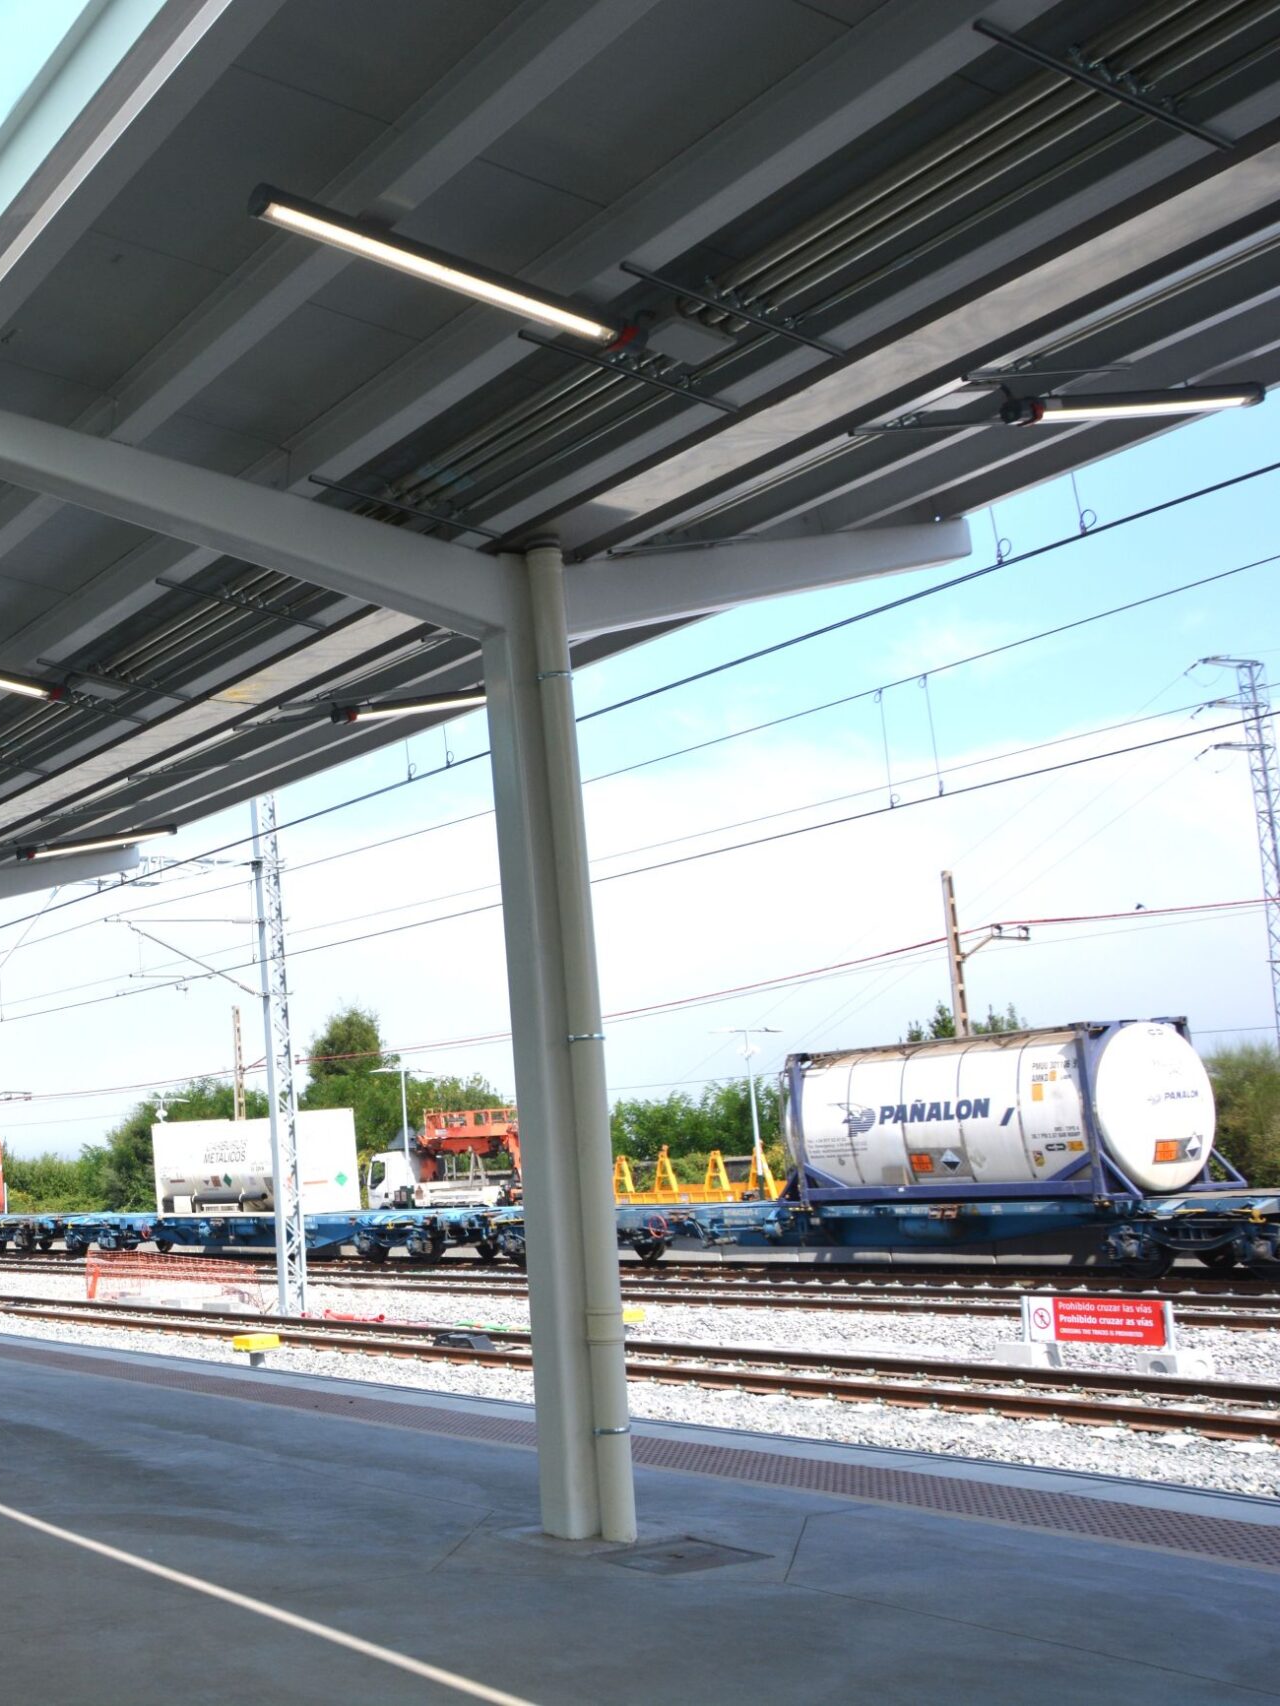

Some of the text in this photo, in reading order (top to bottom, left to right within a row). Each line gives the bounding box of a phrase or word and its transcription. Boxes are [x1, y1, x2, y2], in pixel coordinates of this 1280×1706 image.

[878, 1097, 990, 1125] PAÑALON
[1058, 1301, 1153, 1314] Prohibido cruzar las vías
[1059, 1314, 1154, 1327] Prohibido cruzar as vías
